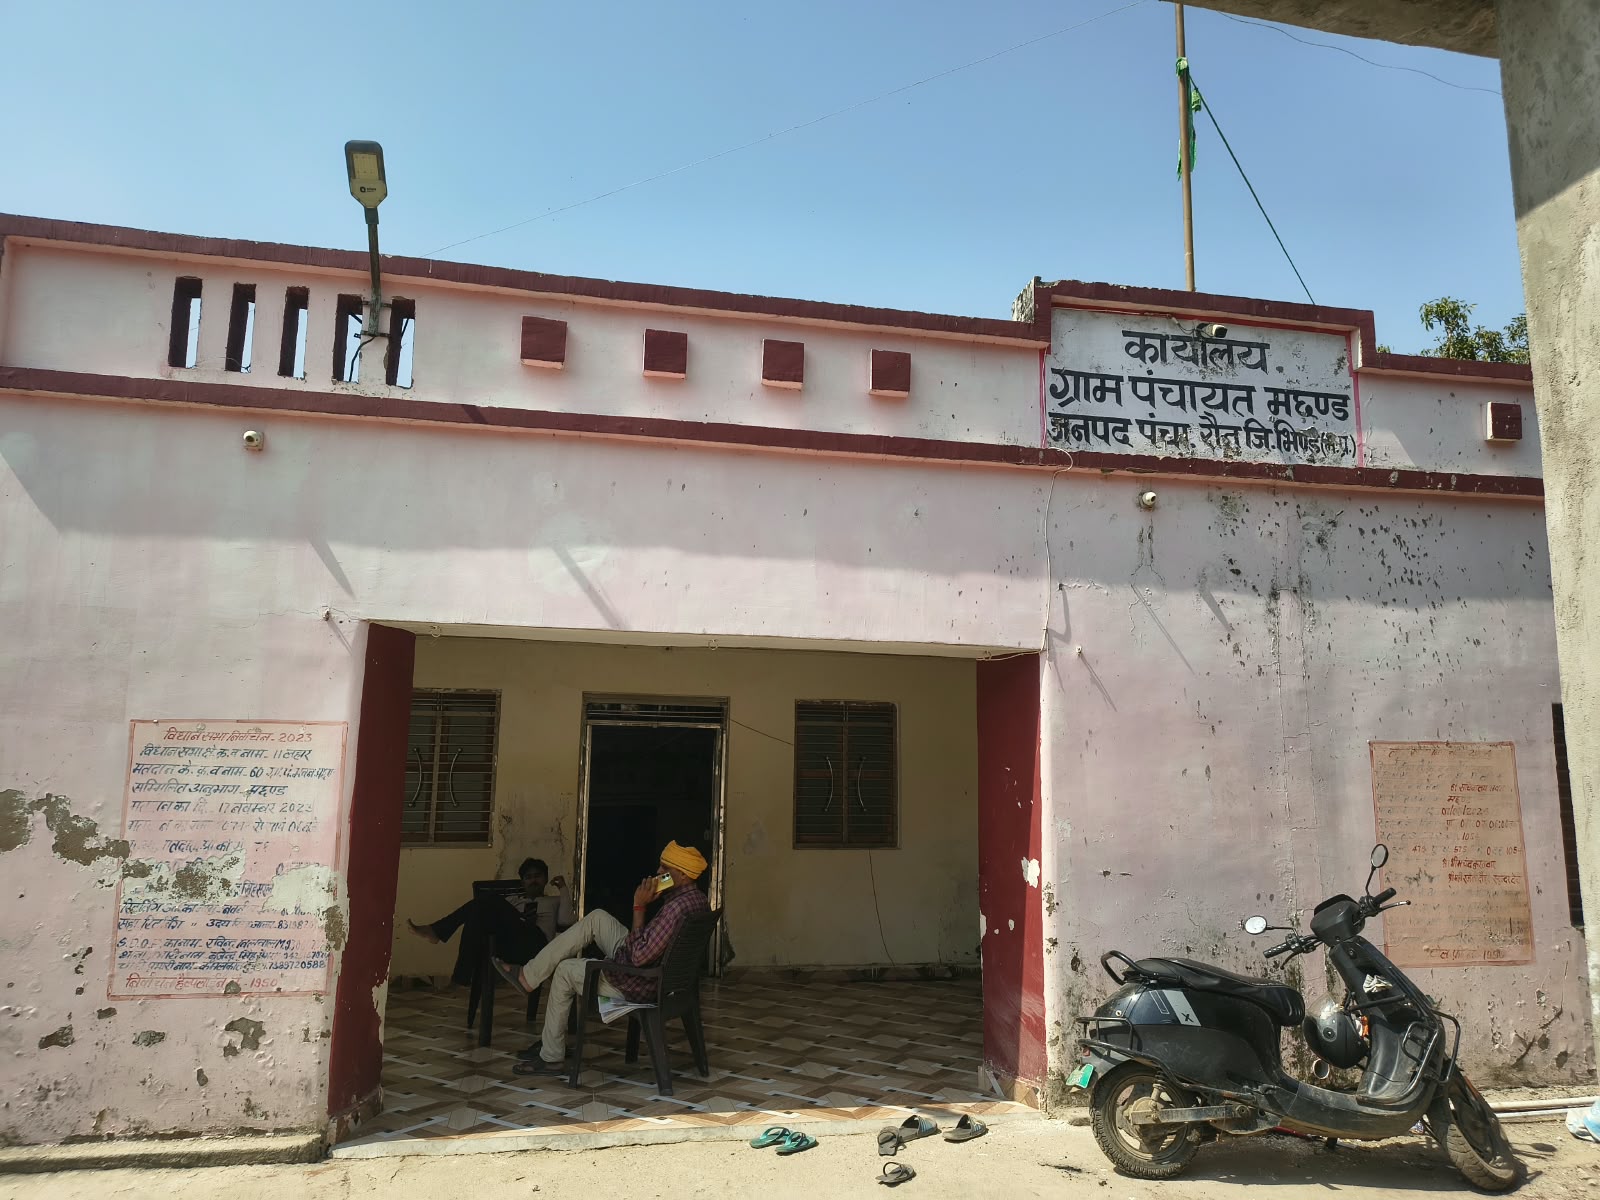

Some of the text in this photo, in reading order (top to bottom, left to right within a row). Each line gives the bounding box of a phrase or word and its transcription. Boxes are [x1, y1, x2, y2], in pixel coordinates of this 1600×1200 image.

[1049, 367, 1351, 422] ग्राम पंचायत मछण्ड
[1047, 411, 1134, 448] जनपद
[279, 732, 313, 744] 2023
[248, 769, 264, 780] 60
